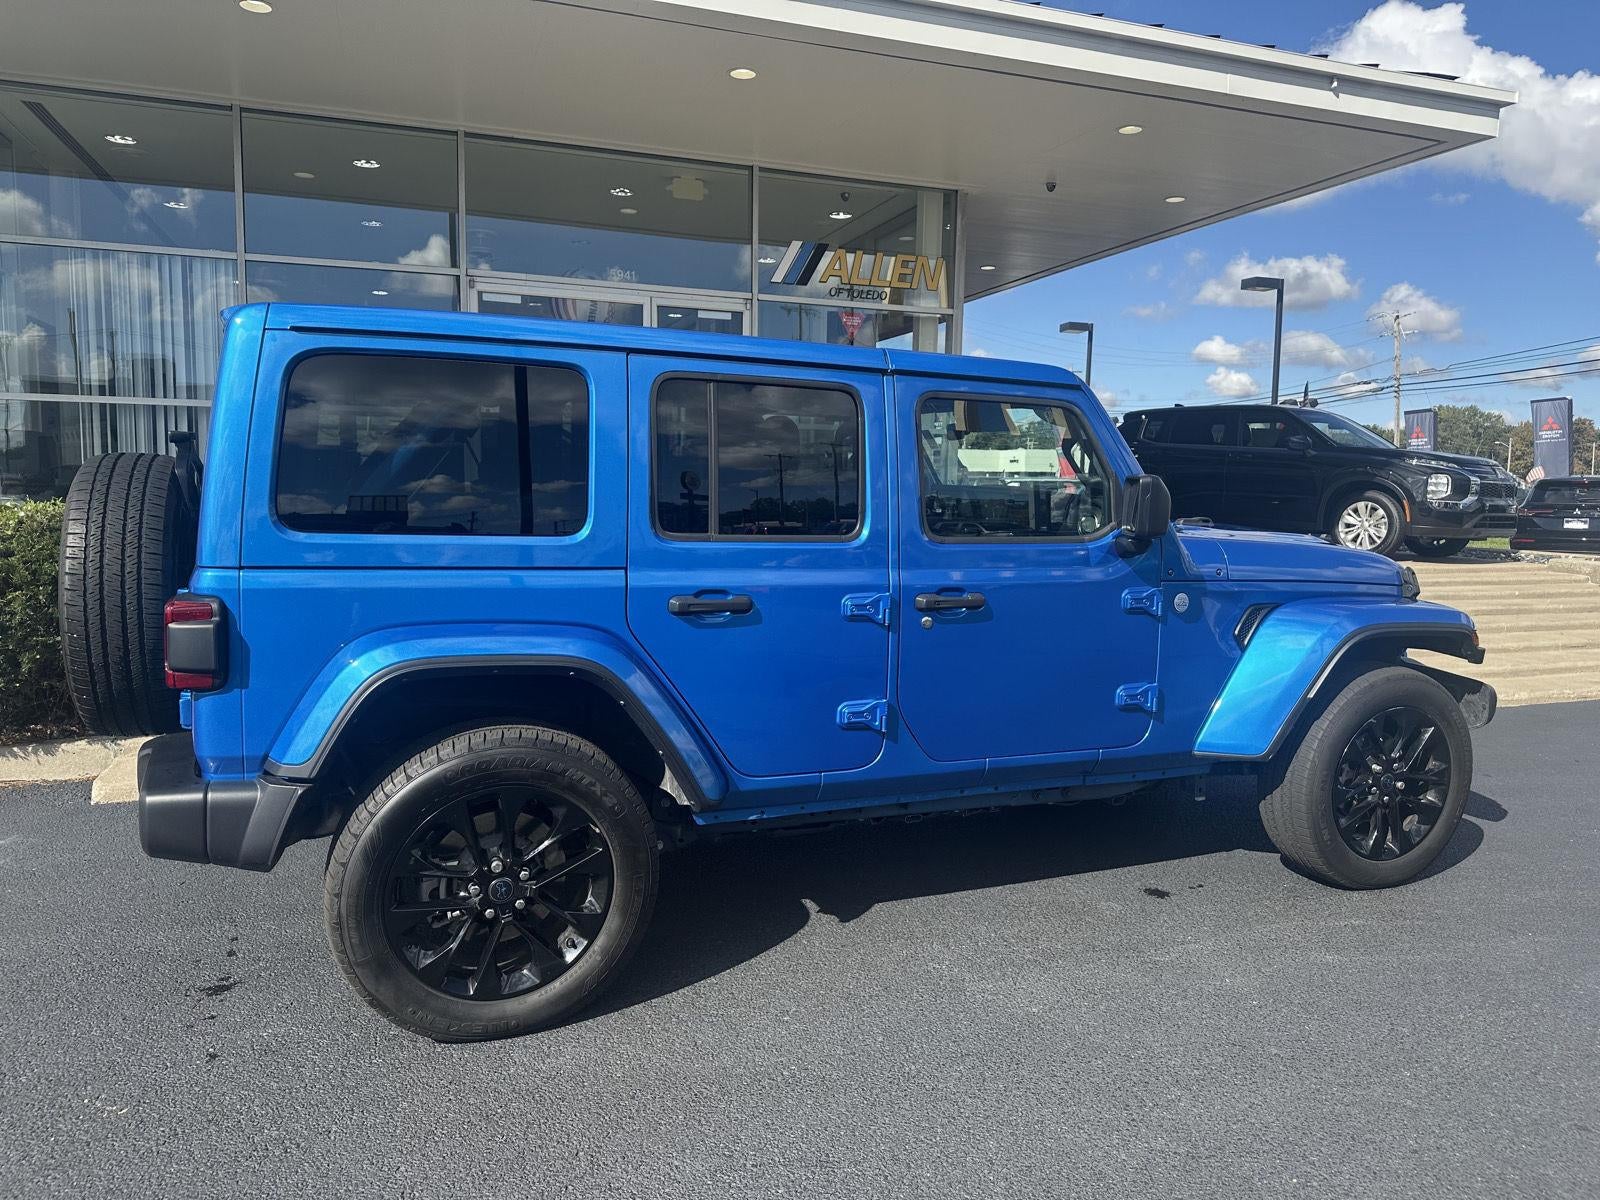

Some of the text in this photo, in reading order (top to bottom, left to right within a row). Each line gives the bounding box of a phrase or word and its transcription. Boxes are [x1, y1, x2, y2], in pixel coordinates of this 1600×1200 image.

[609, 268, 635, 281] 5941
[819, 247, 945, 291] ALLEN
[829, 286, 888, 300] OF TOLEDO
